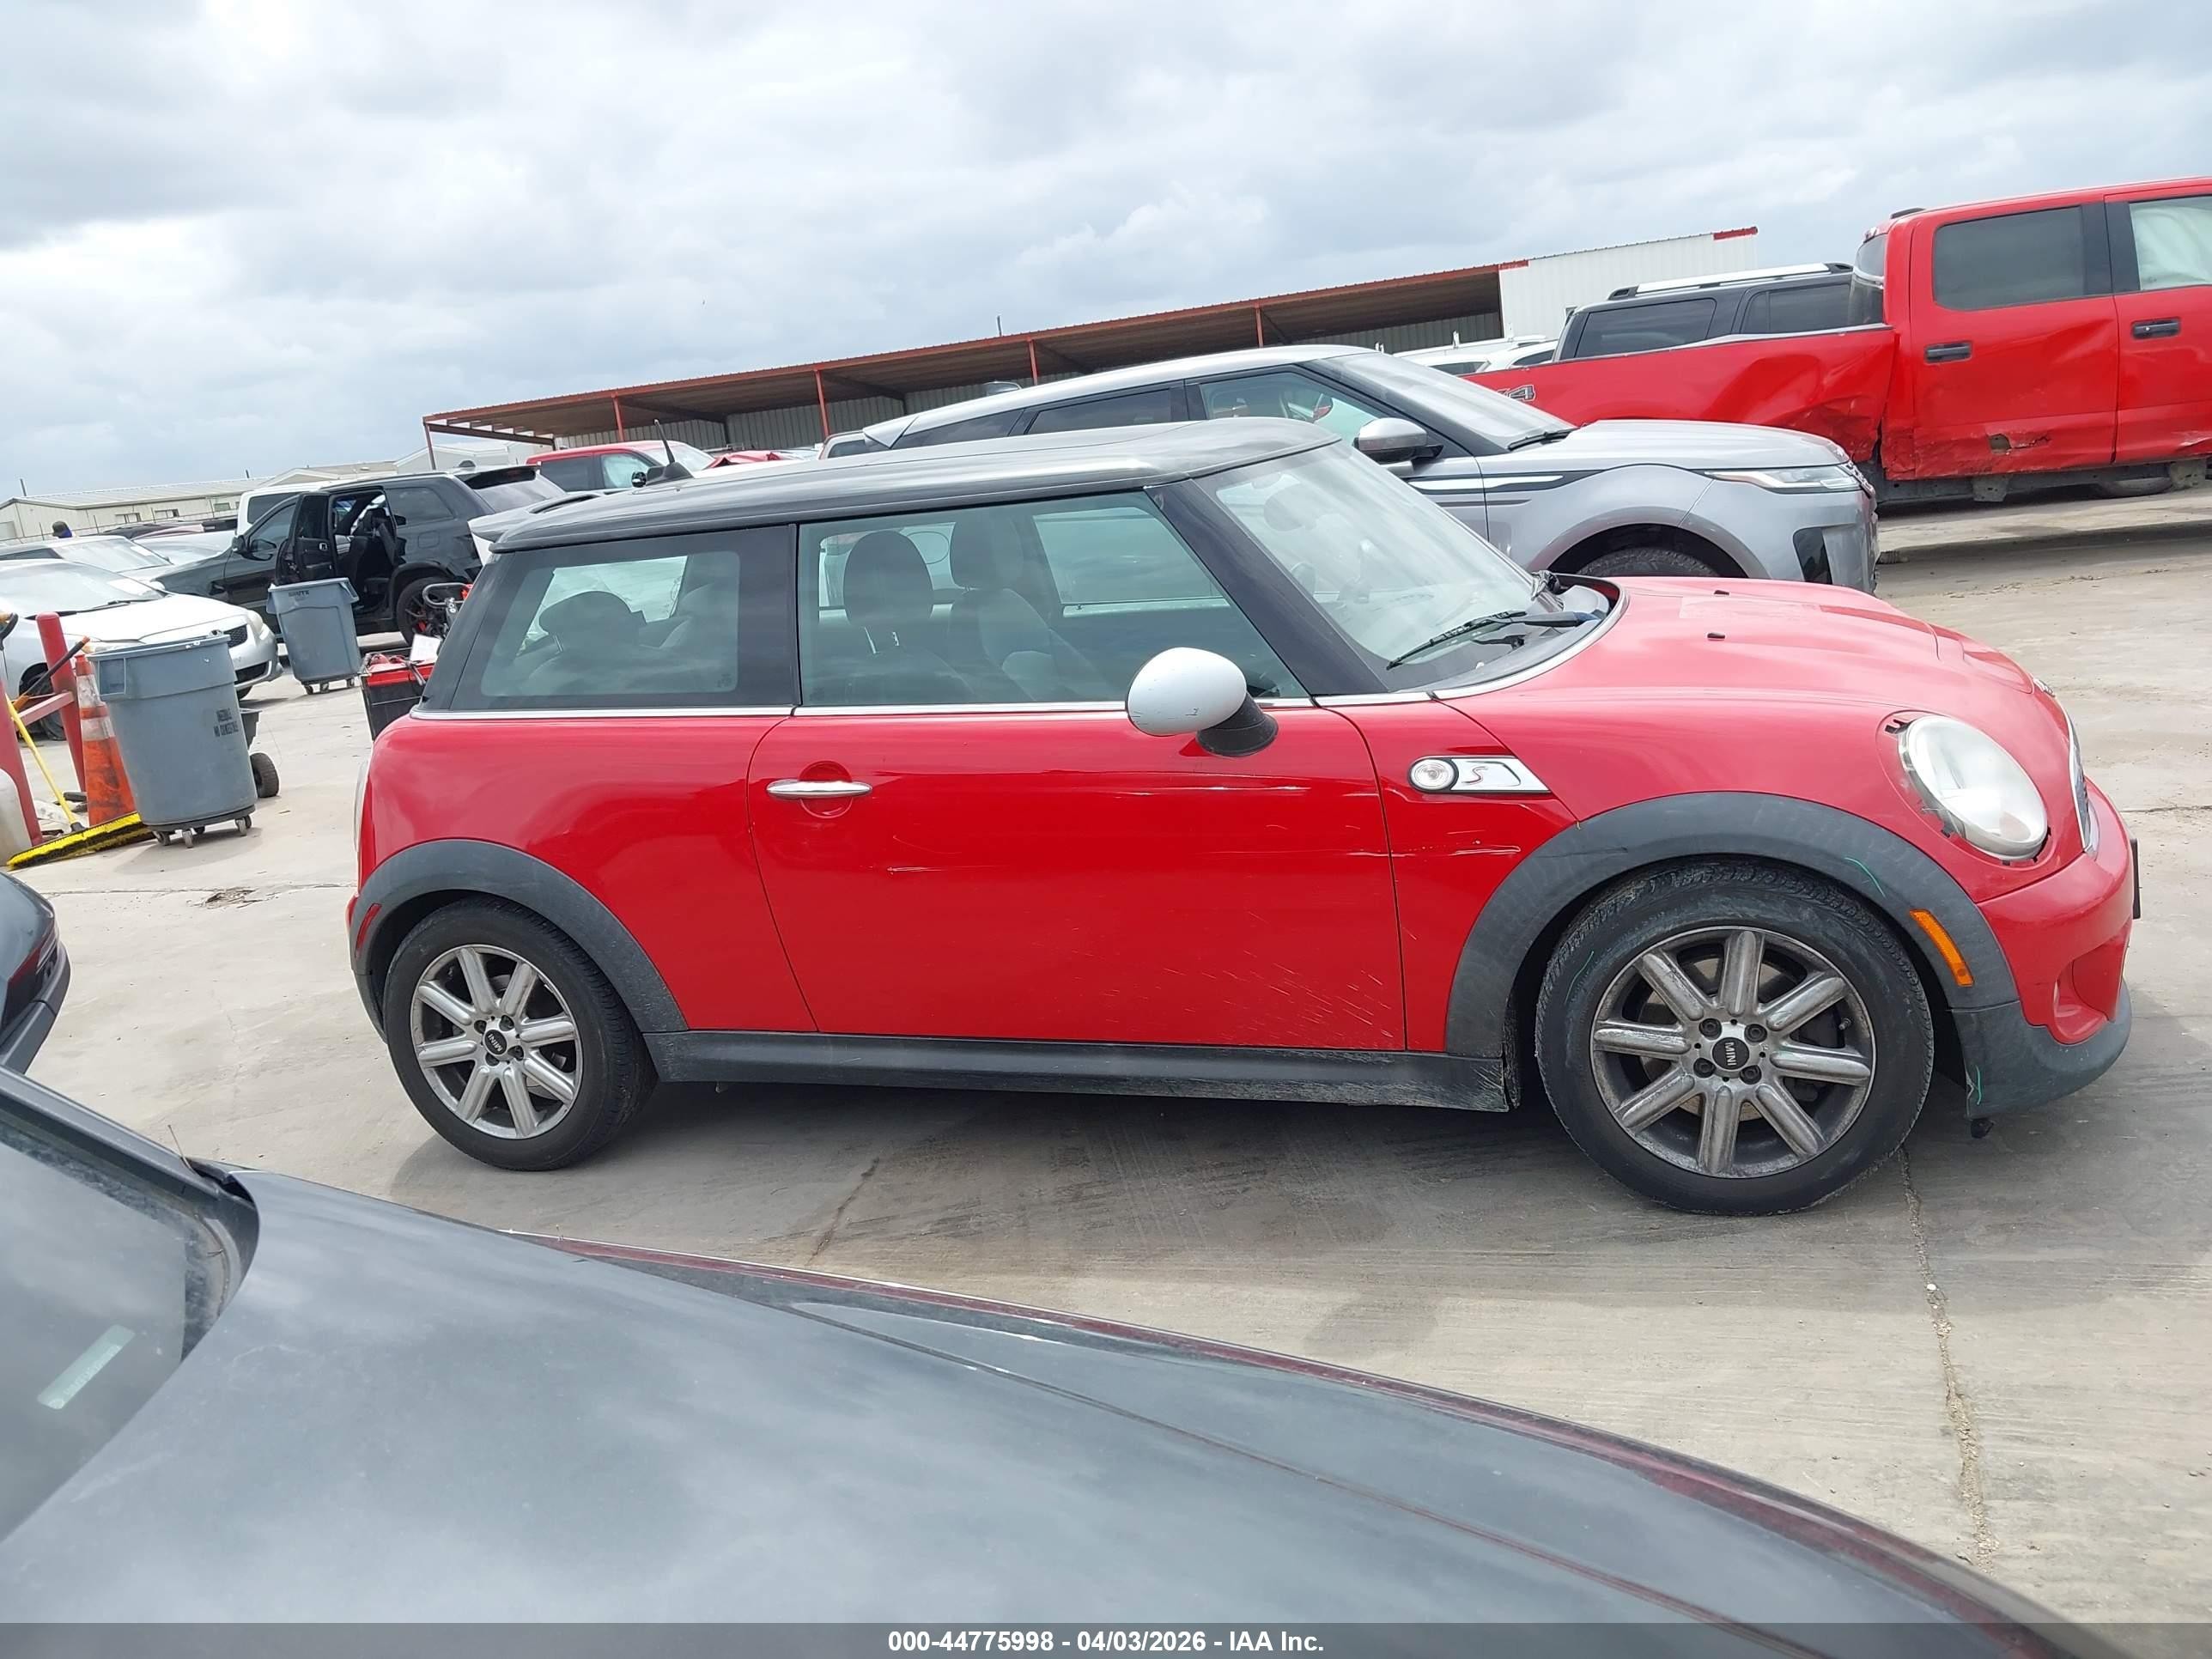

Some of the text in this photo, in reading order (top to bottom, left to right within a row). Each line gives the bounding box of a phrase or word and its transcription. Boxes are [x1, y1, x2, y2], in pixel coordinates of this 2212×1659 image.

[1461, 765, 1488, 786] S
[487, 1033, 503, 1052] MINI
[1724, 1042, 1737, 1066] MINI
